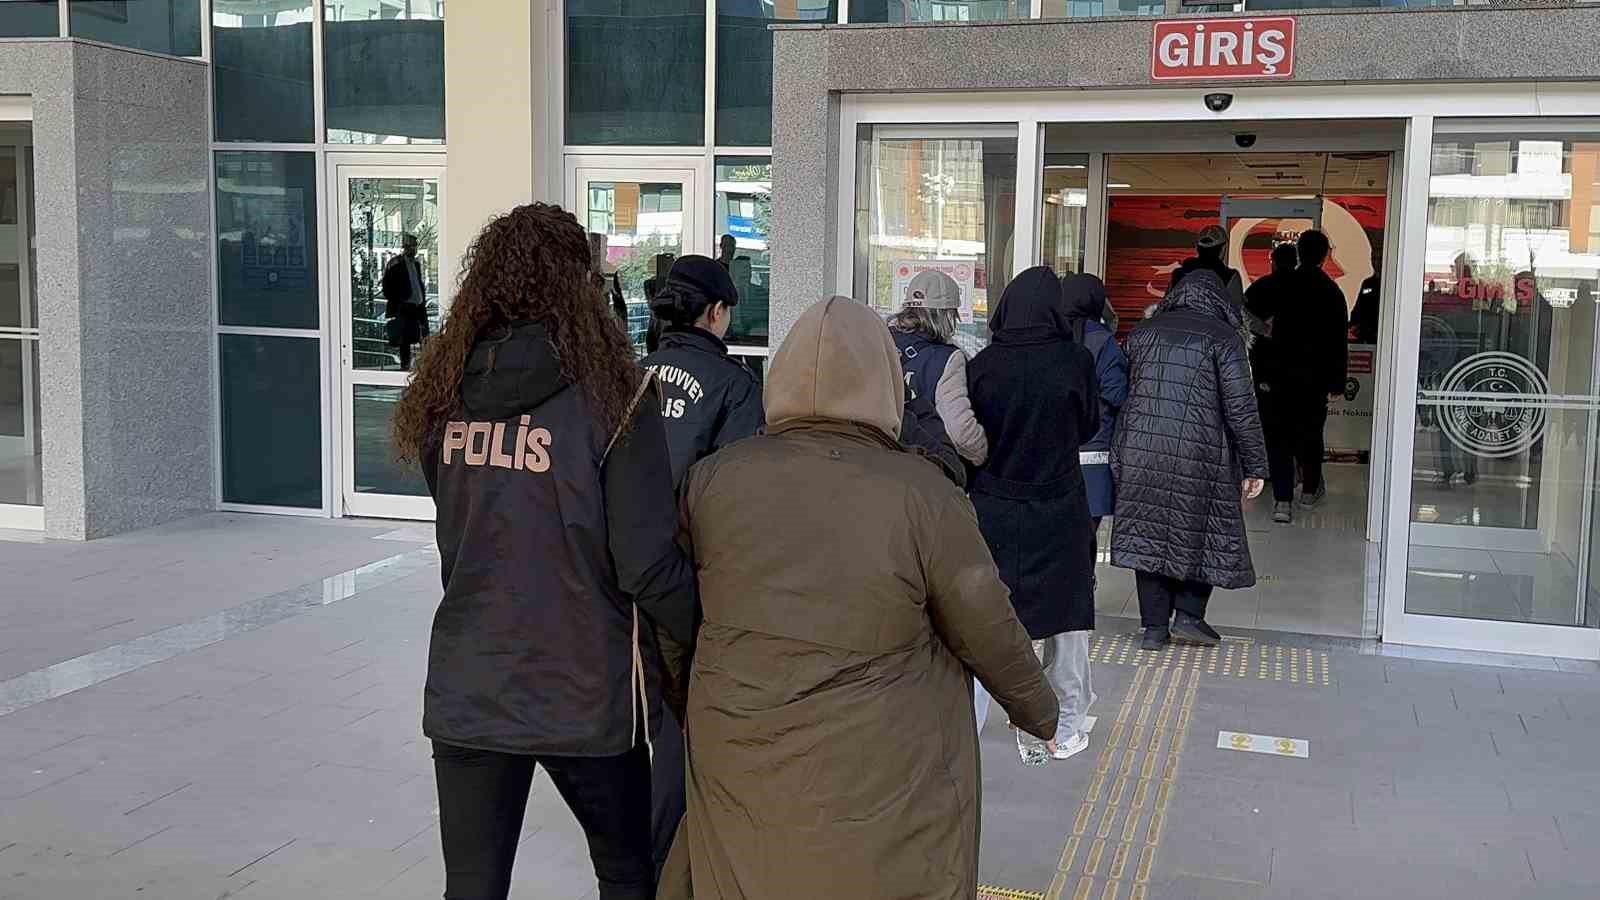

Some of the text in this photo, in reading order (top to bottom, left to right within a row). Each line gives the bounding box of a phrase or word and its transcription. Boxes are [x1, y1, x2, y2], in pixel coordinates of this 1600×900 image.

[1159, 22, 1286, 75] GİRİŞ
[659, 365, 704, 405] KUVVET
[1489, 368, 1508, 378] T.C.
[443, 414, 552, 473] POLİS
[1471, 427, 1511, 442] ADALET
